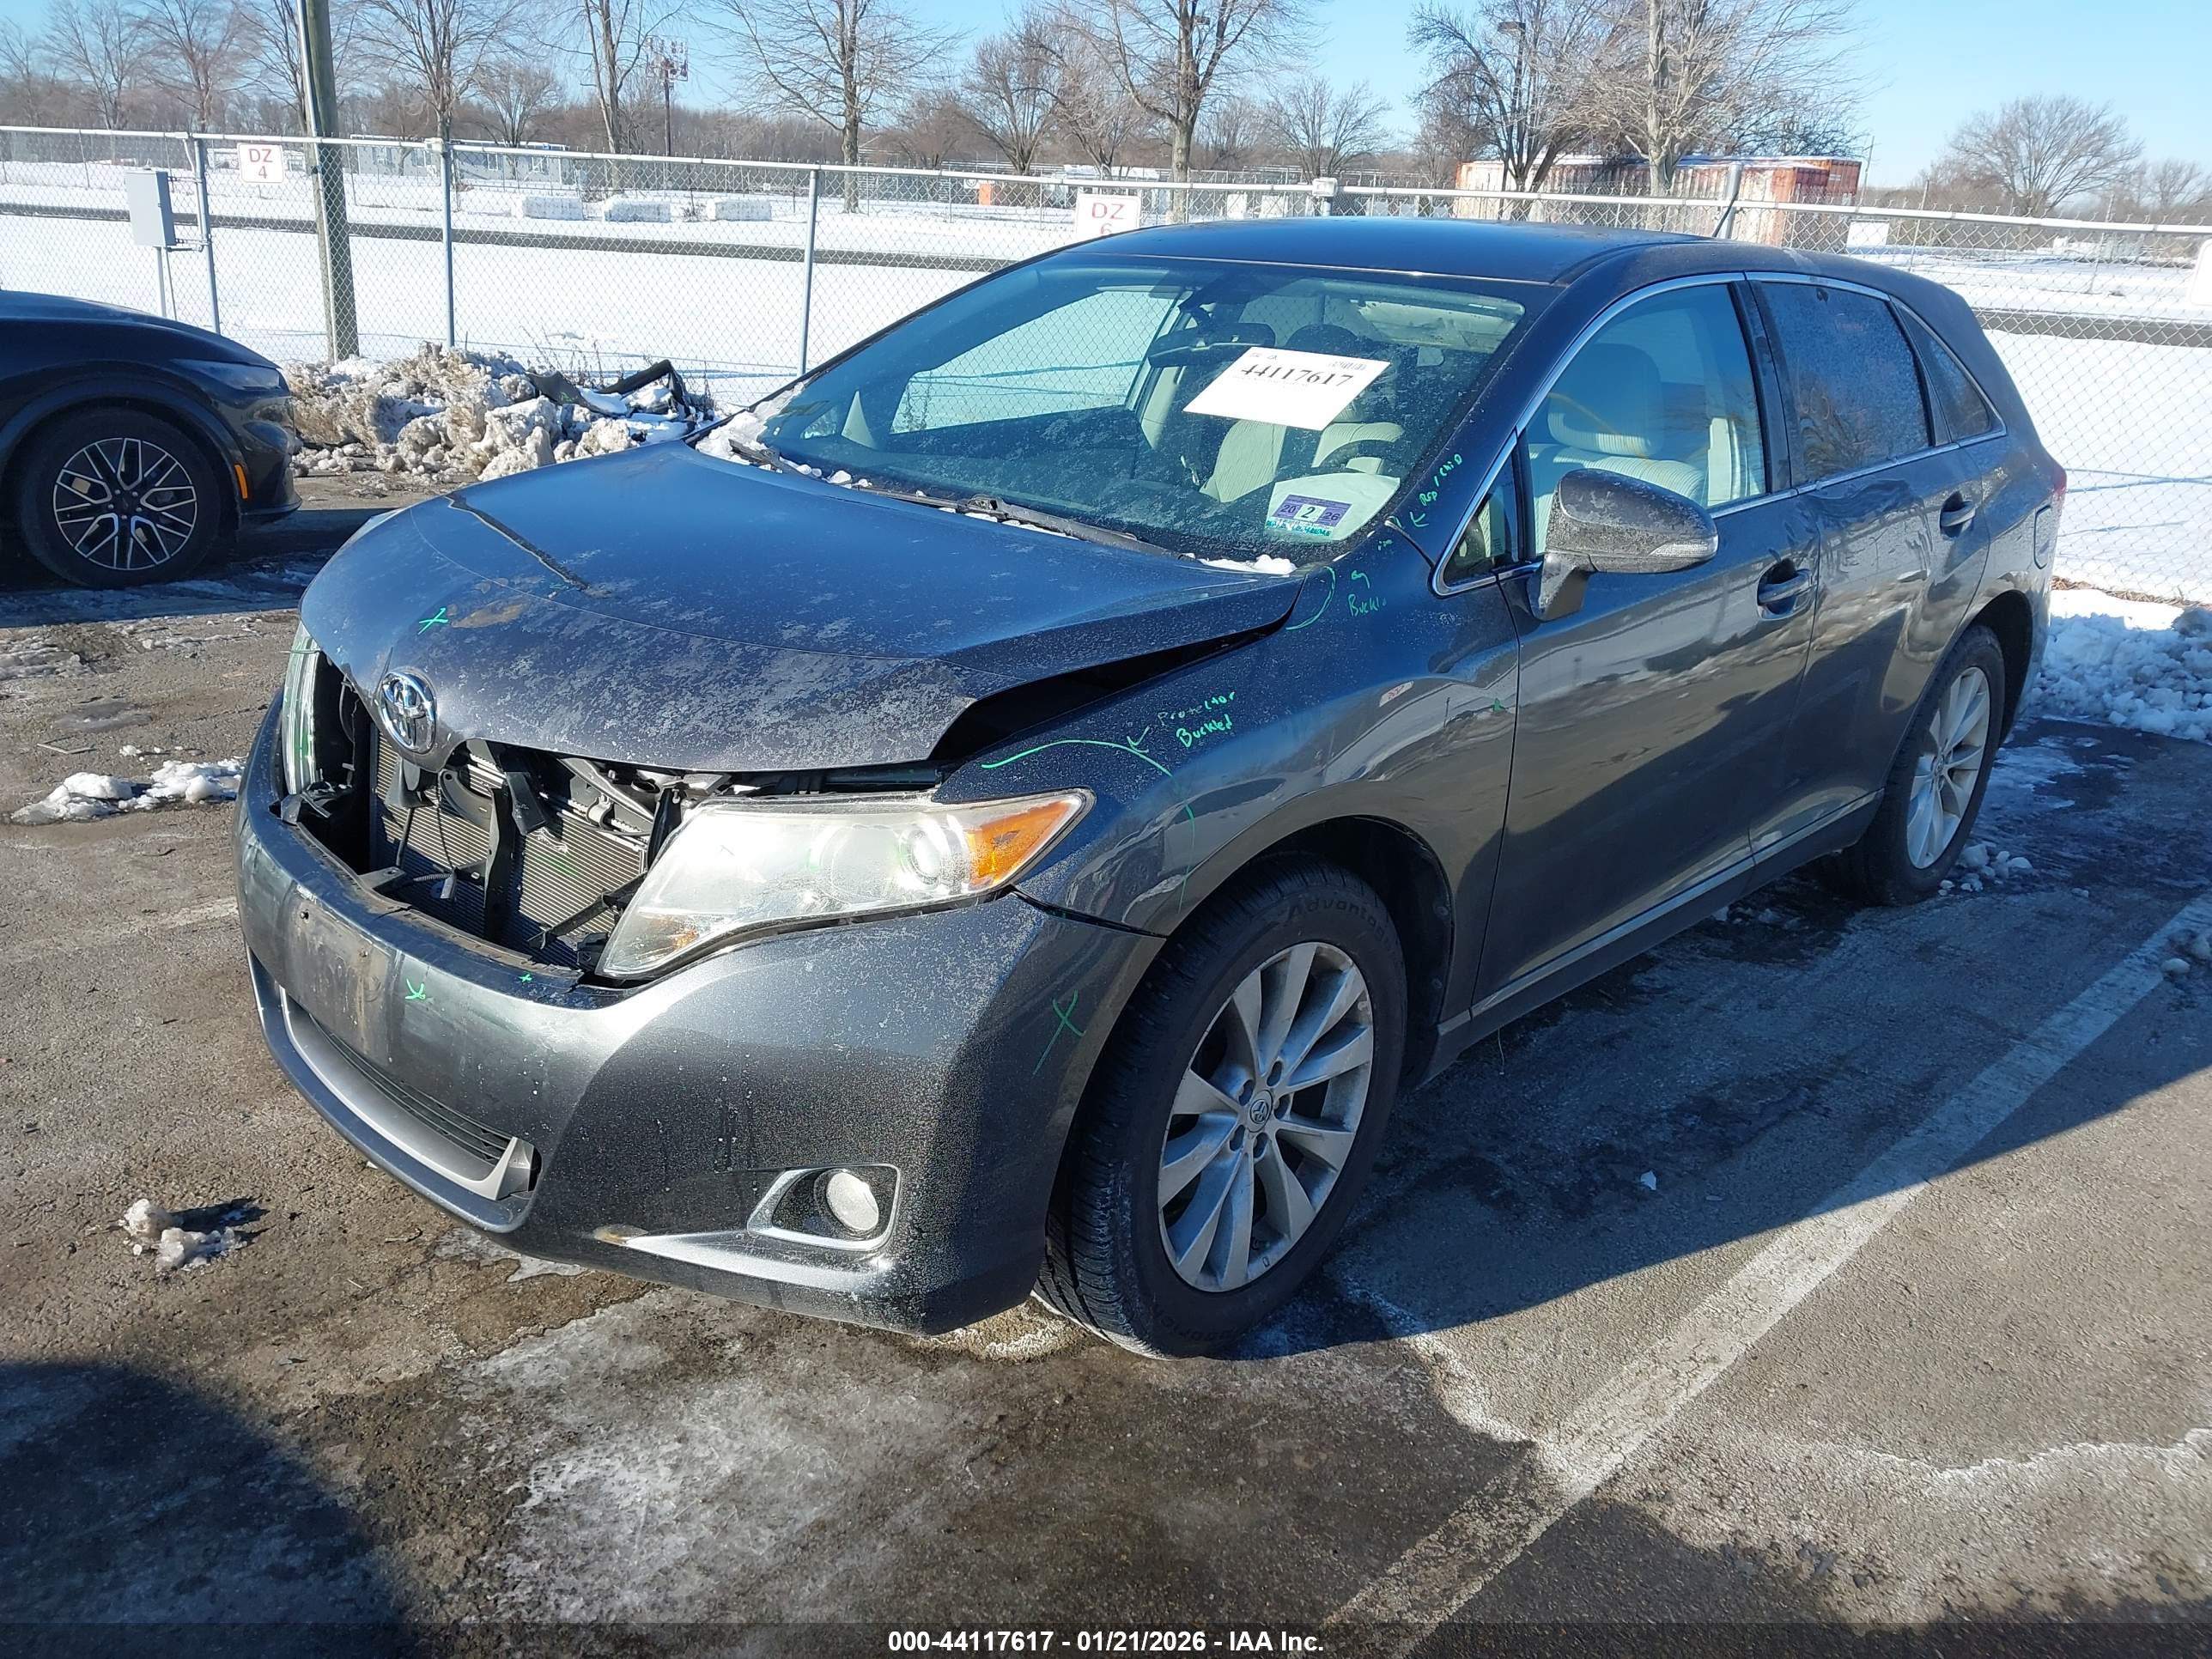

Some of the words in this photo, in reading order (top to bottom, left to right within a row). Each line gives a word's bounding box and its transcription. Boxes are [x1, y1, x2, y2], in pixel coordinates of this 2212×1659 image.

[248, 148, 273, 163] DZ
[258, 165, 268, 179] 4
[1091, 202, 1127, 220] DZ
[1241, 363, 1354, 387] 44117617
[1280, 504, 1297, 514] 20
[1301, 506, 1316, 520] 2
[1323, 512, 1340, 521] 26
